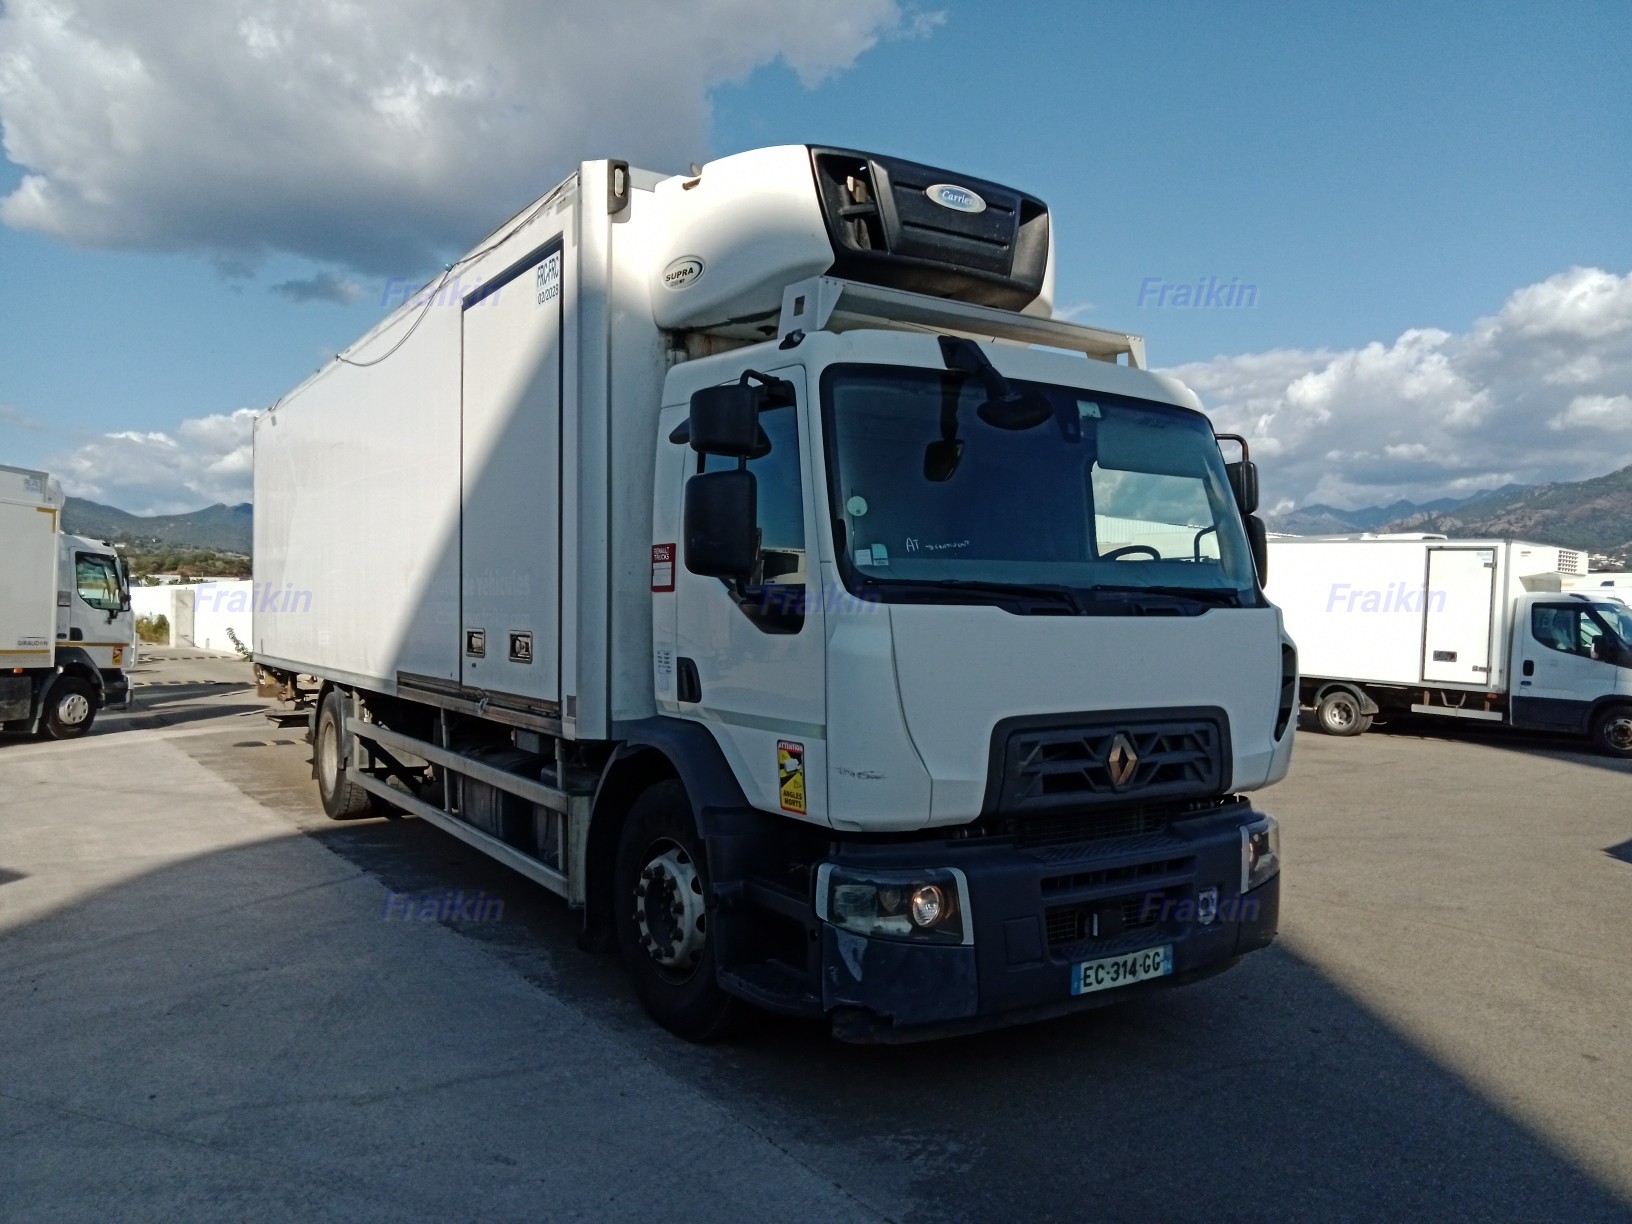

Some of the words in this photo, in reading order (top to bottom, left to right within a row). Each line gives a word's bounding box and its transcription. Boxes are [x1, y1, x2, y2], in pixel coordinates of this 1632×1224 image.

[665, 266, 694, 282] SUPRA
[783, 790, 802, 801] ANGLES
[784, 798, 802, 808] MORTS
[1083, 951, 1161, 987] EC-314-GG
